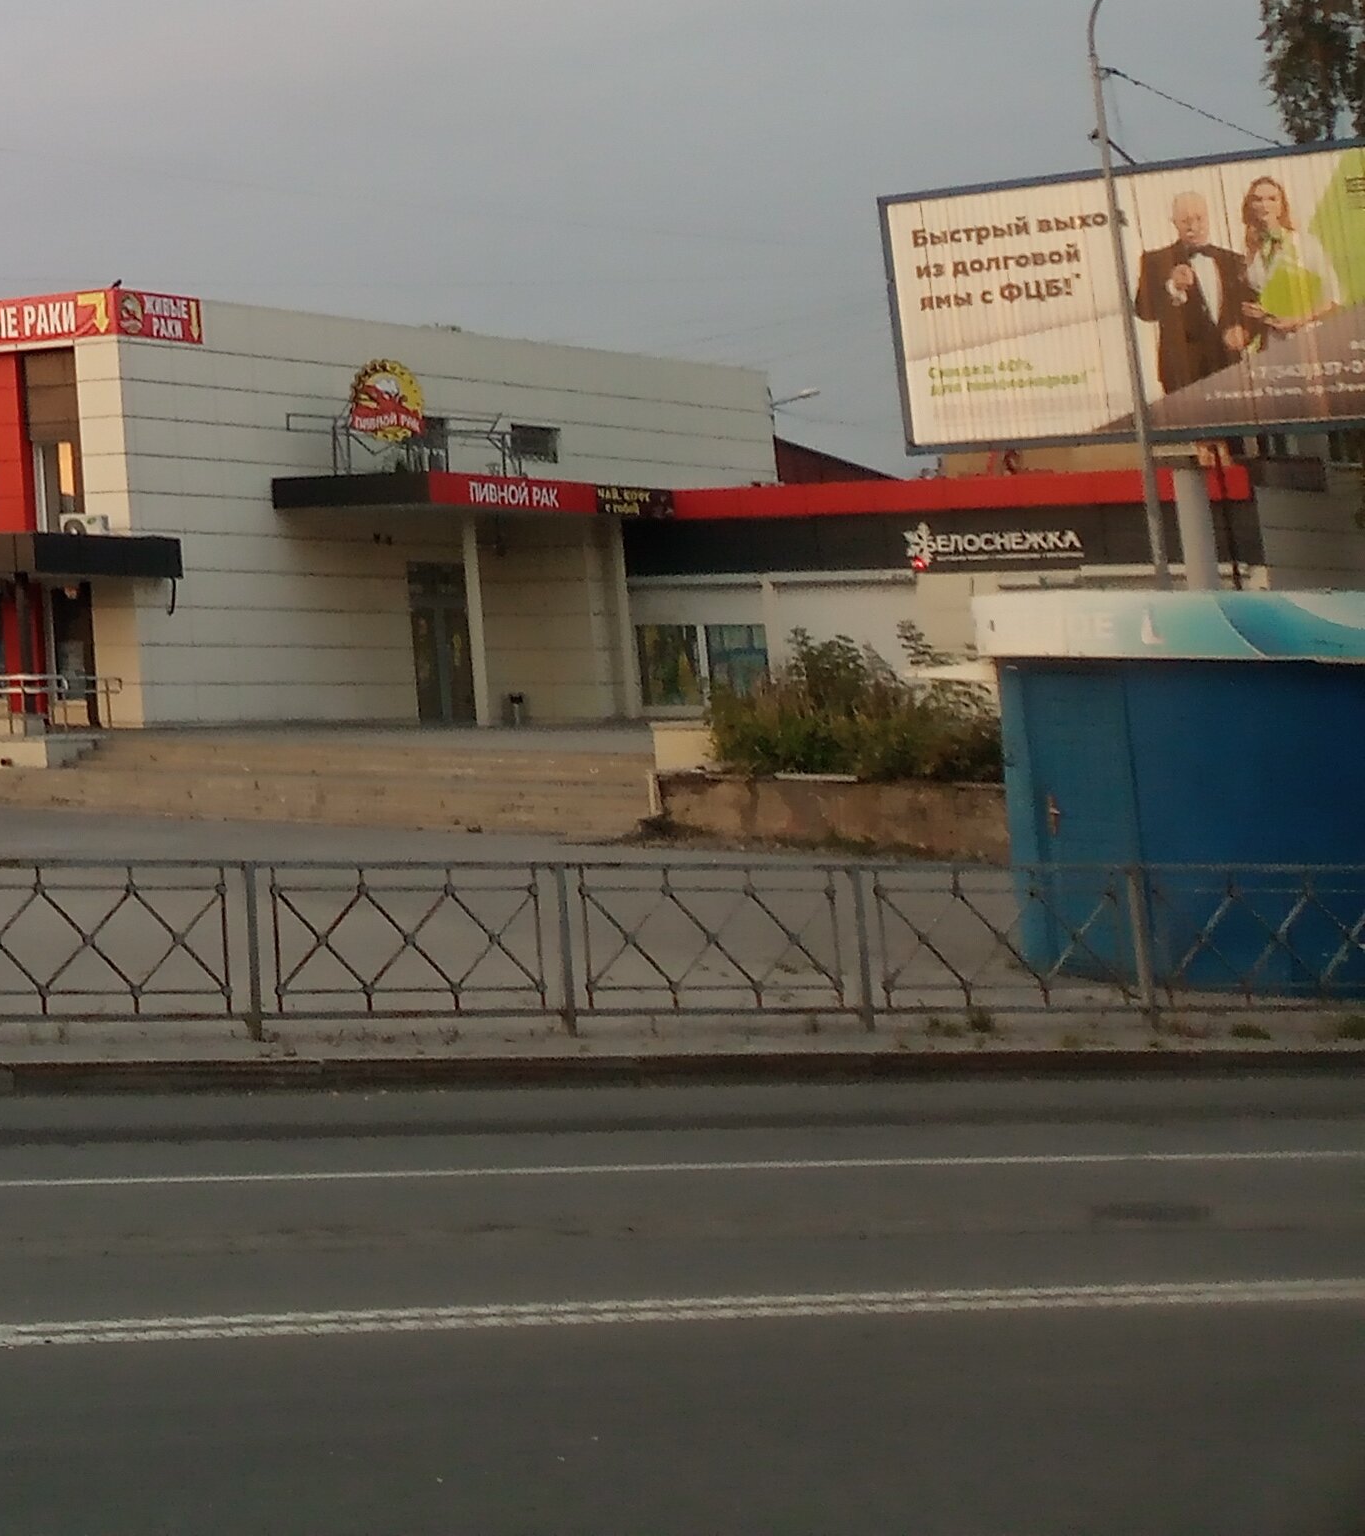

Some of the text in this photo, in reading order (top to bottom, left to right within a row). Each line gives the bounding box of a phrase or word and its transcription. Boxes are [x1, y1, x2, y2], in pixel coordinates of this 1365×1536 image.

[911, 216, 1030, 248] Быстрый
[916, 243, 1081, 279] из долговой
[144, 295, 189, 319] ЖИВЫЕ
[920, 291, 973, 311] ямы
[980, 290, 994, 304] с
[23, 301, 76, 337] РАКИ
[152, 317, 183, 339] РАКИ
[468, 481, 560, 508] ПИВНОЙ РАК
[927, 530, 1082, 553] БЕЛОСНЕЖКА
